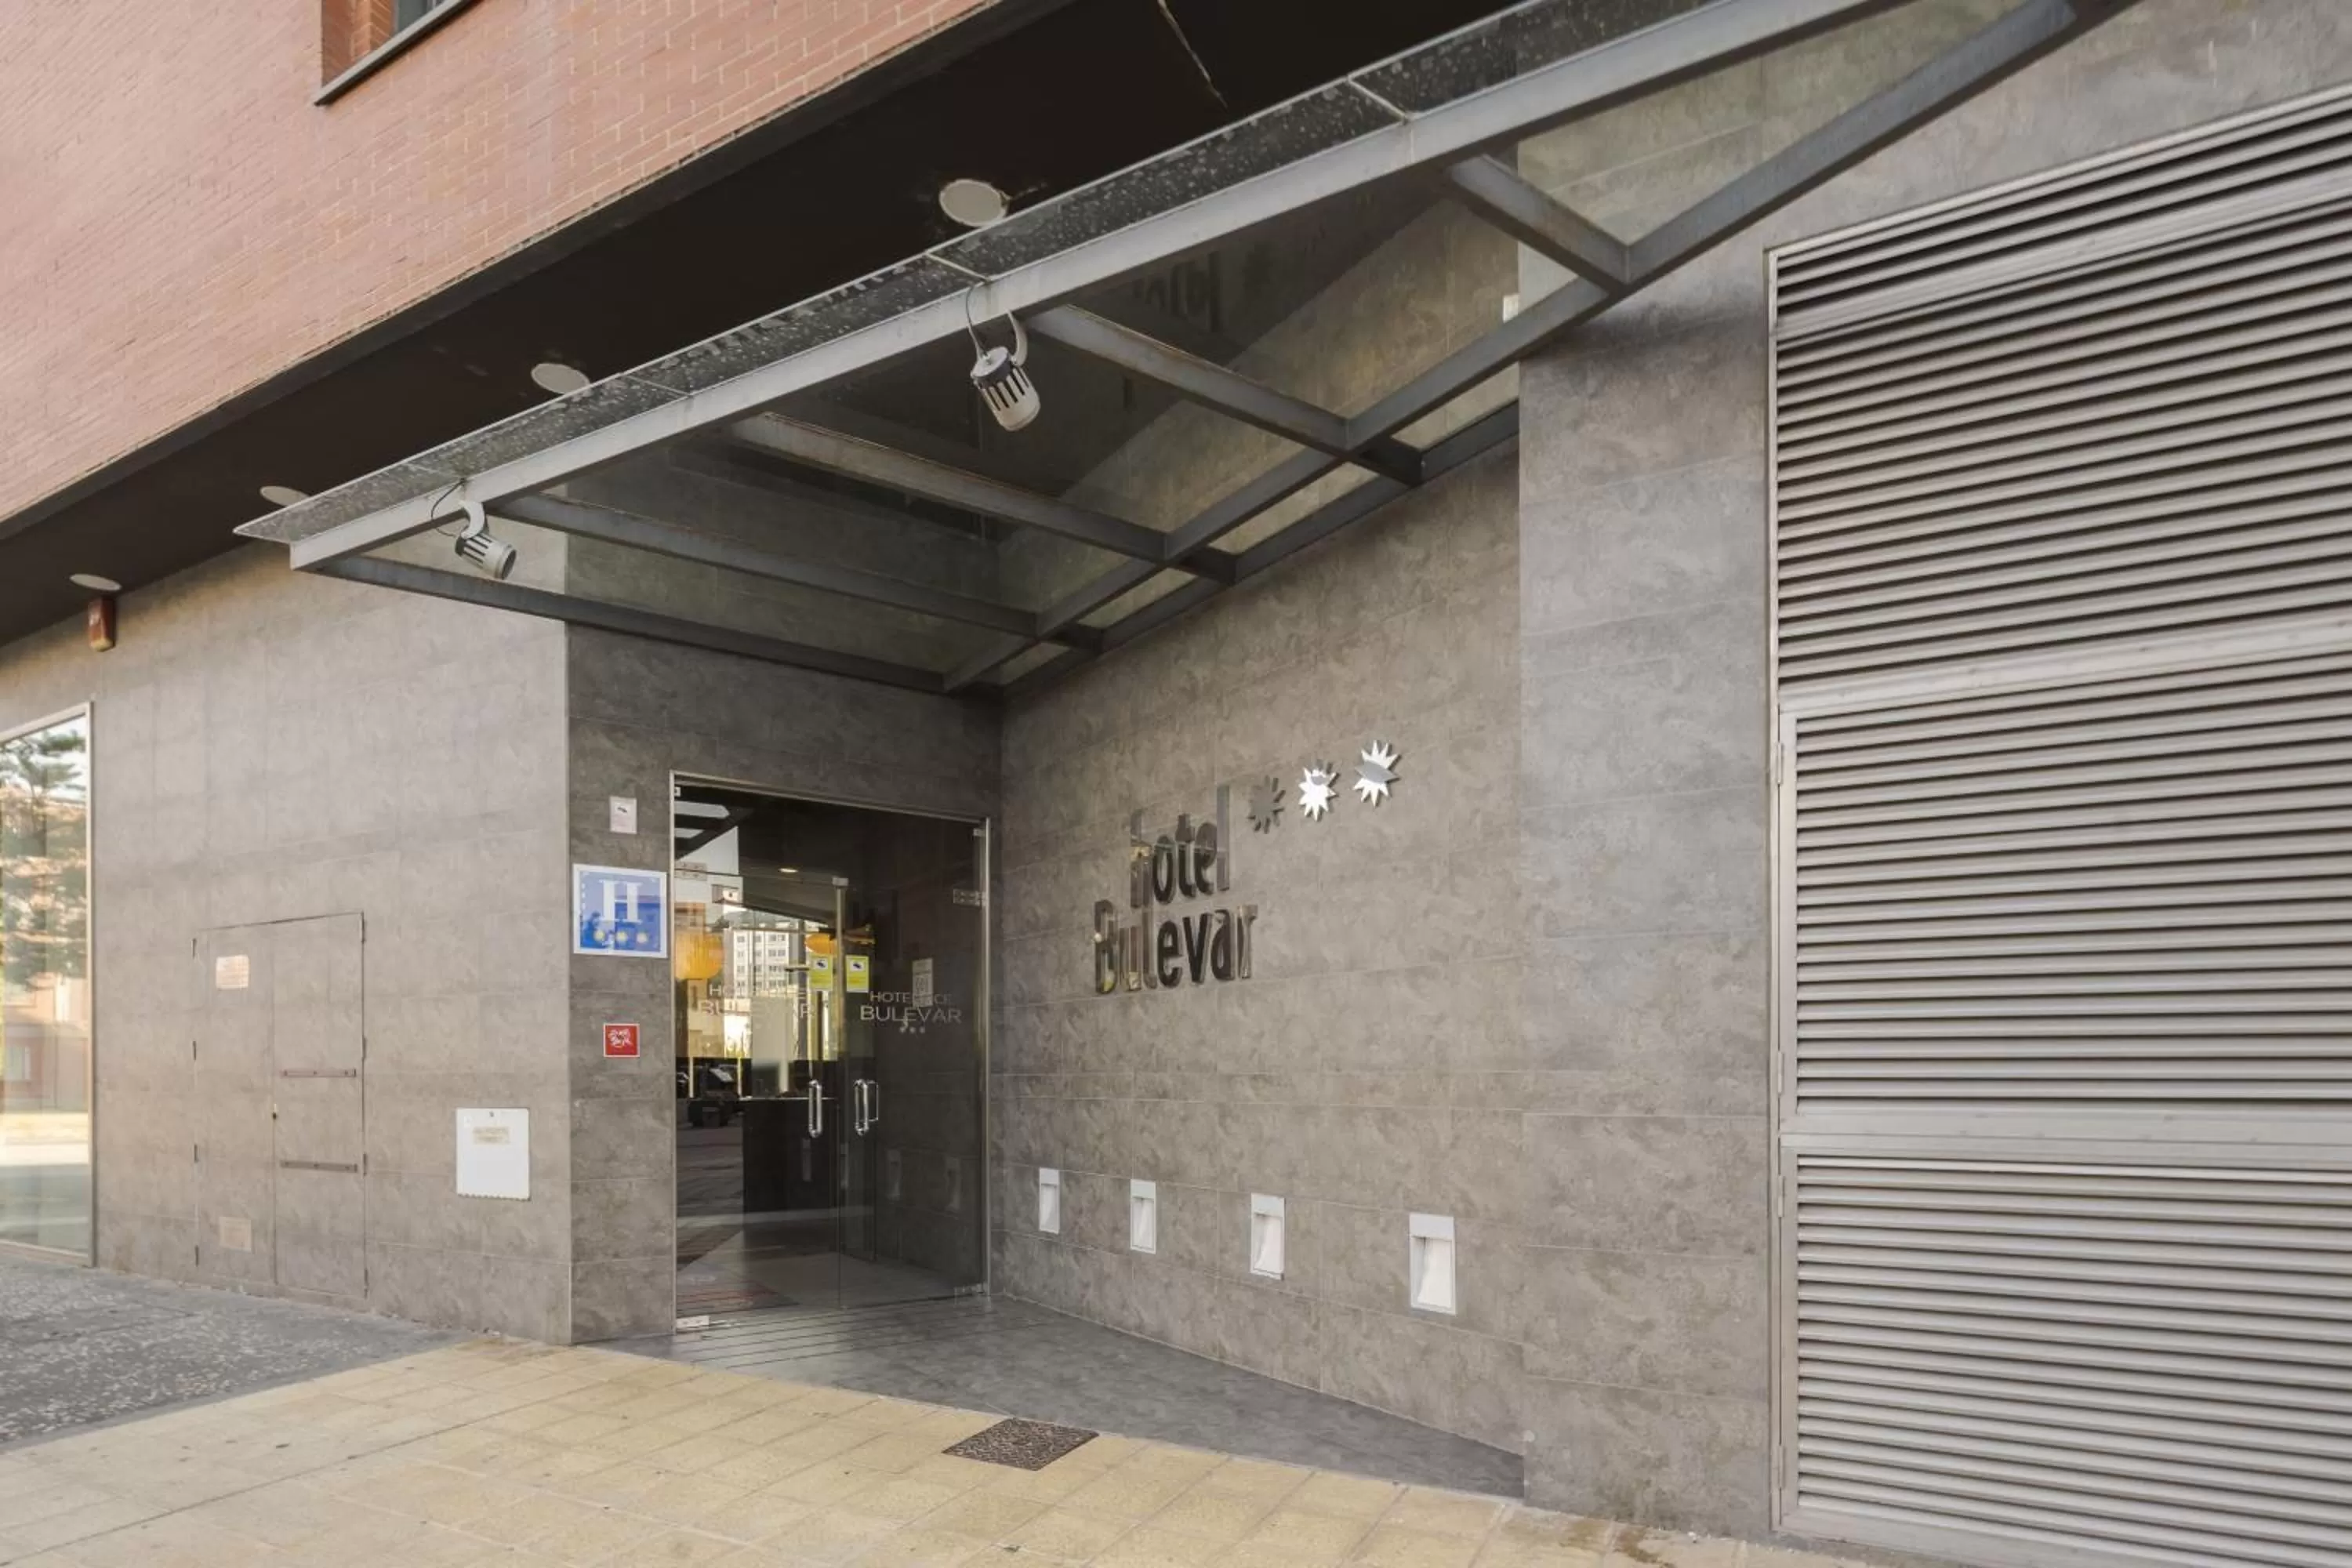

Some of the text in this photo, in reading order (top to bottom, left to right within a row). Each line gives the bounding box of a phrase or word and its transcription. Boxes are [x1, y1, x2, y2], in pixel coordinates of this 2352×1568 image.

[1130, 785, 1229, 909] hotel
[598, 879, 643, 924] H
[1094, 899, 1258, 994] Bulevar
[860, 1004, 963, 1024] BULEVAR
[869, 991, 914, 1003] HOTE
